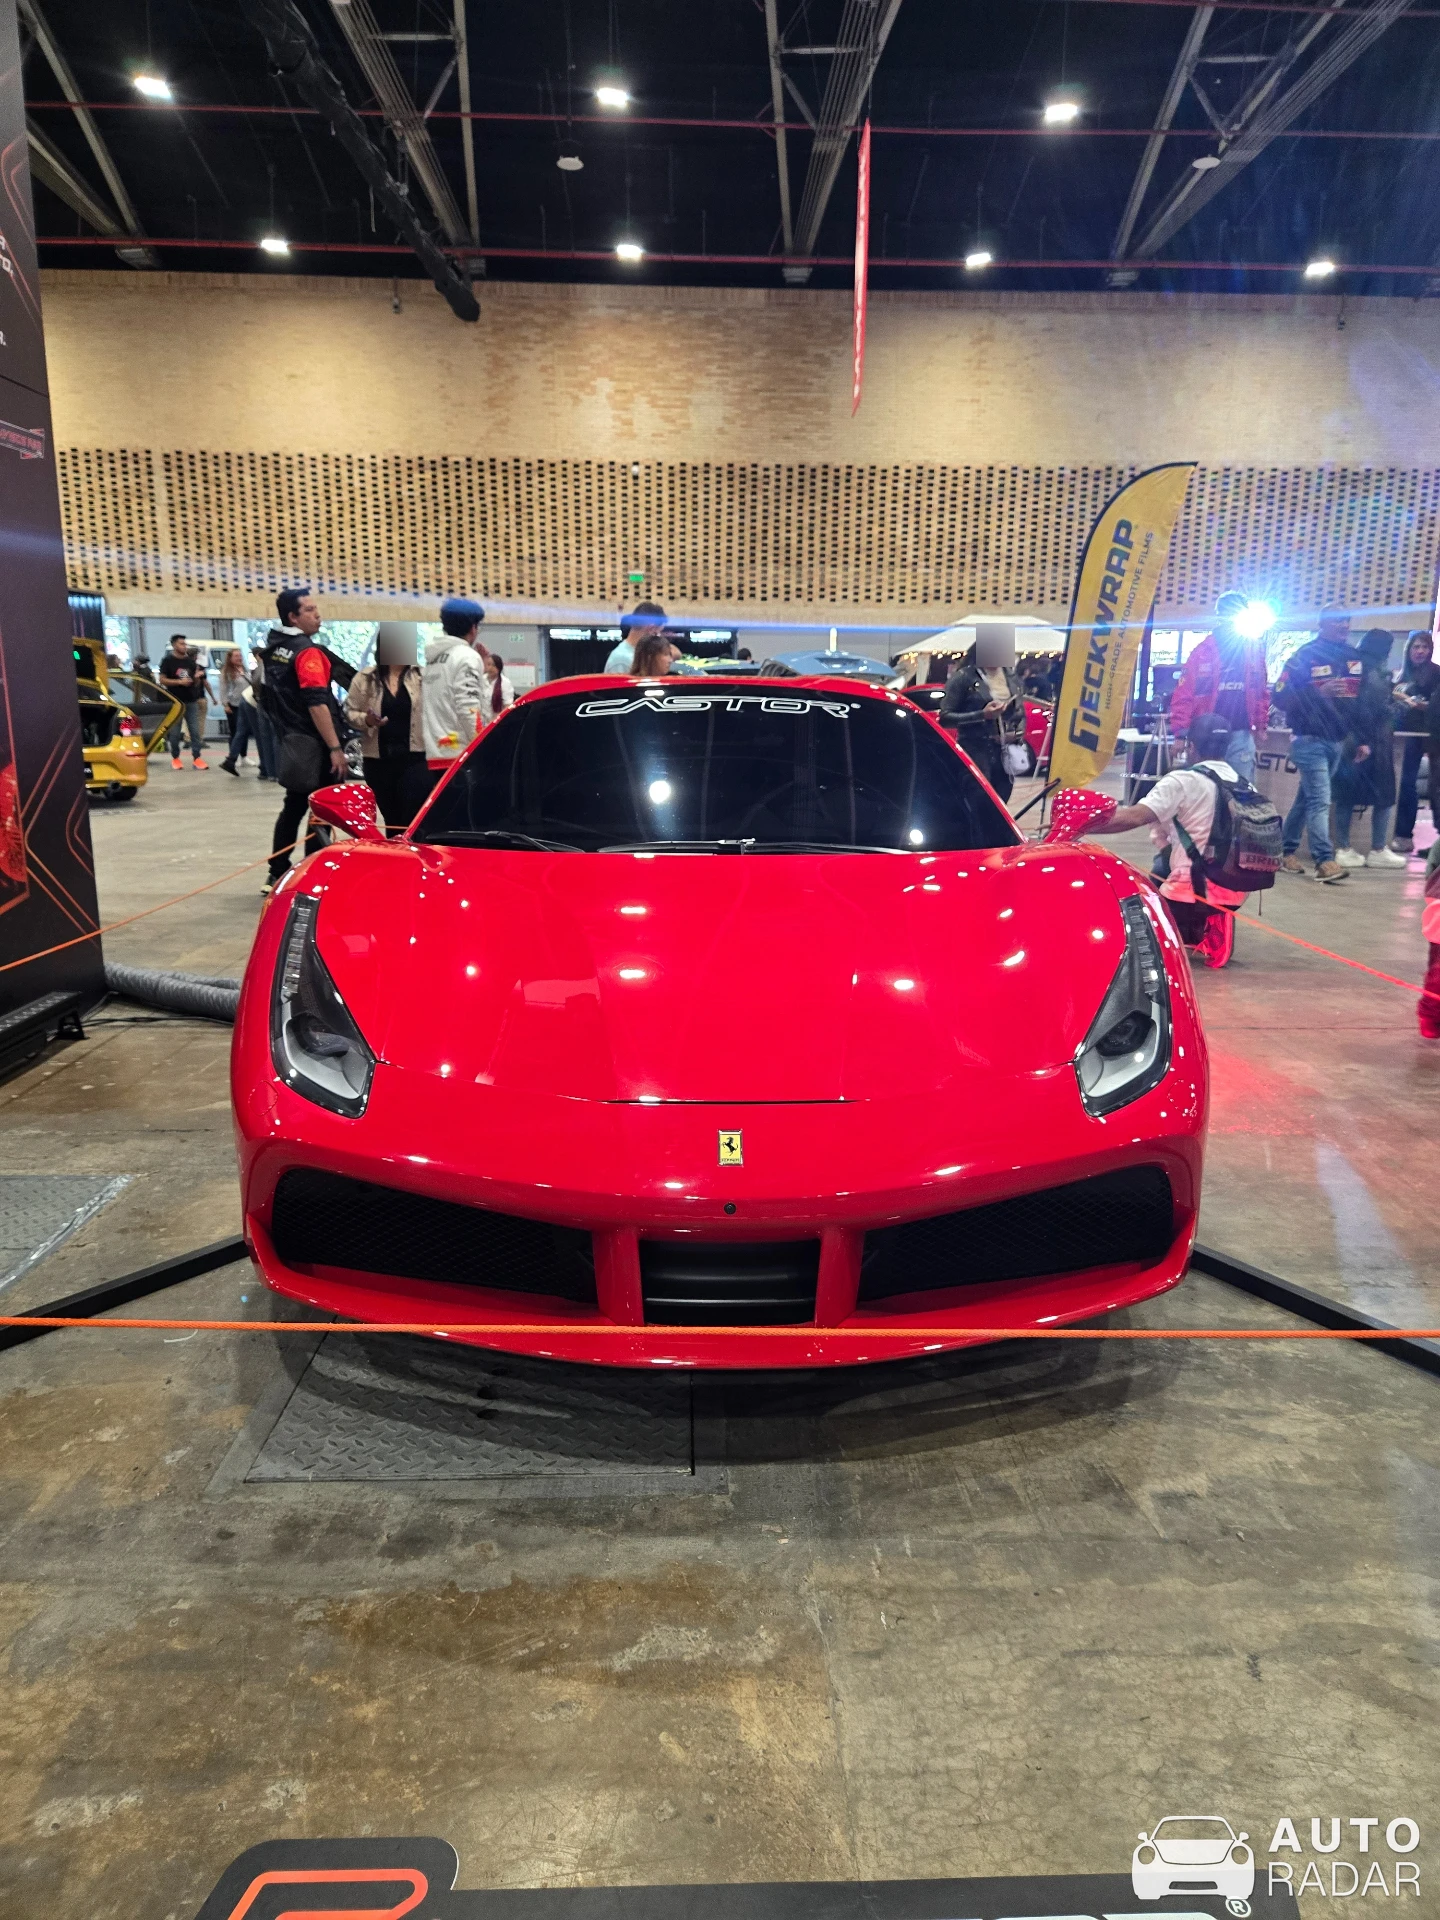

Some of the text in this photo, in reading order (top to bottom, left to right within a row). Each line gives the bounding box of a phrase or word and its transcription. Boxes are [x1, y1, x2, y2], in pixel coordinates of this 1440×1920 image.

[576, 695, 850, 718] CASTOR
[1069, 519, 1133, 752] TECKWRAP
[1105, 532, 1154, 710] HIGH-GRADE AUTOMOTIVE FILMS
